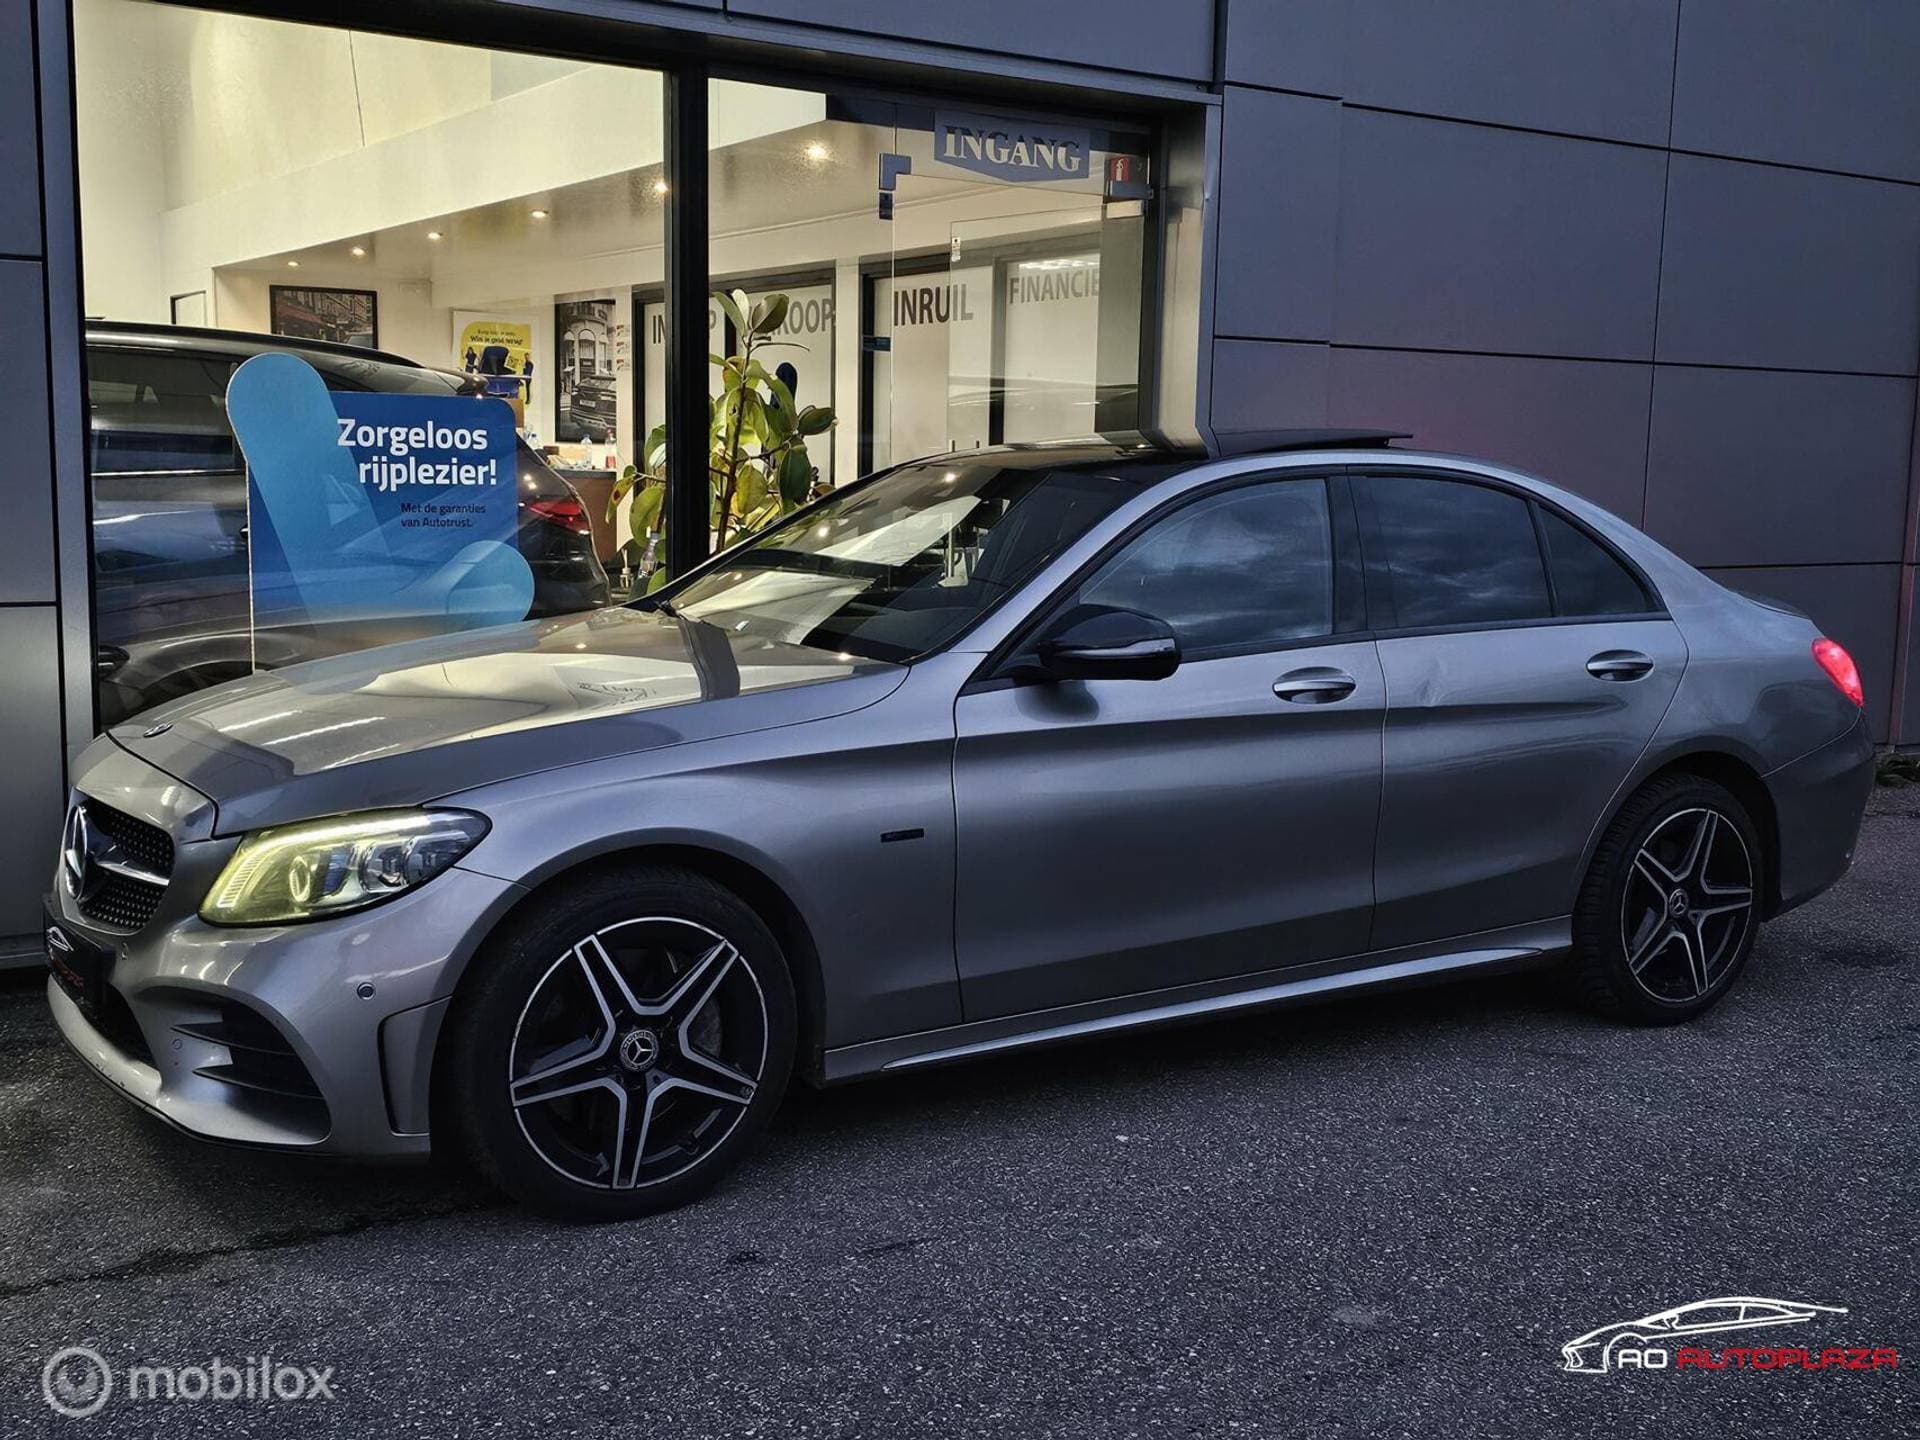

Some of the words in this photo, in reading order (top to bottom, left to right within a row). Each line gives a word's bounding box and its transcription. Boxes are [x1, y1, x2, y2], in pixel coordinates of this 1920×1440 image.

[943, 124, 1081, 173] INGANG
[893, 283, 974, 327] INRUIL
[336, 418, 488, 456] Zorgeloos
[358, 455, 498, 492] rijplezier!
[400, 503, 421, 513] Met
[424, 503, 437, 513] de
[439, 503, 487, 516] garanties
[401, 519, 420, 528] van
